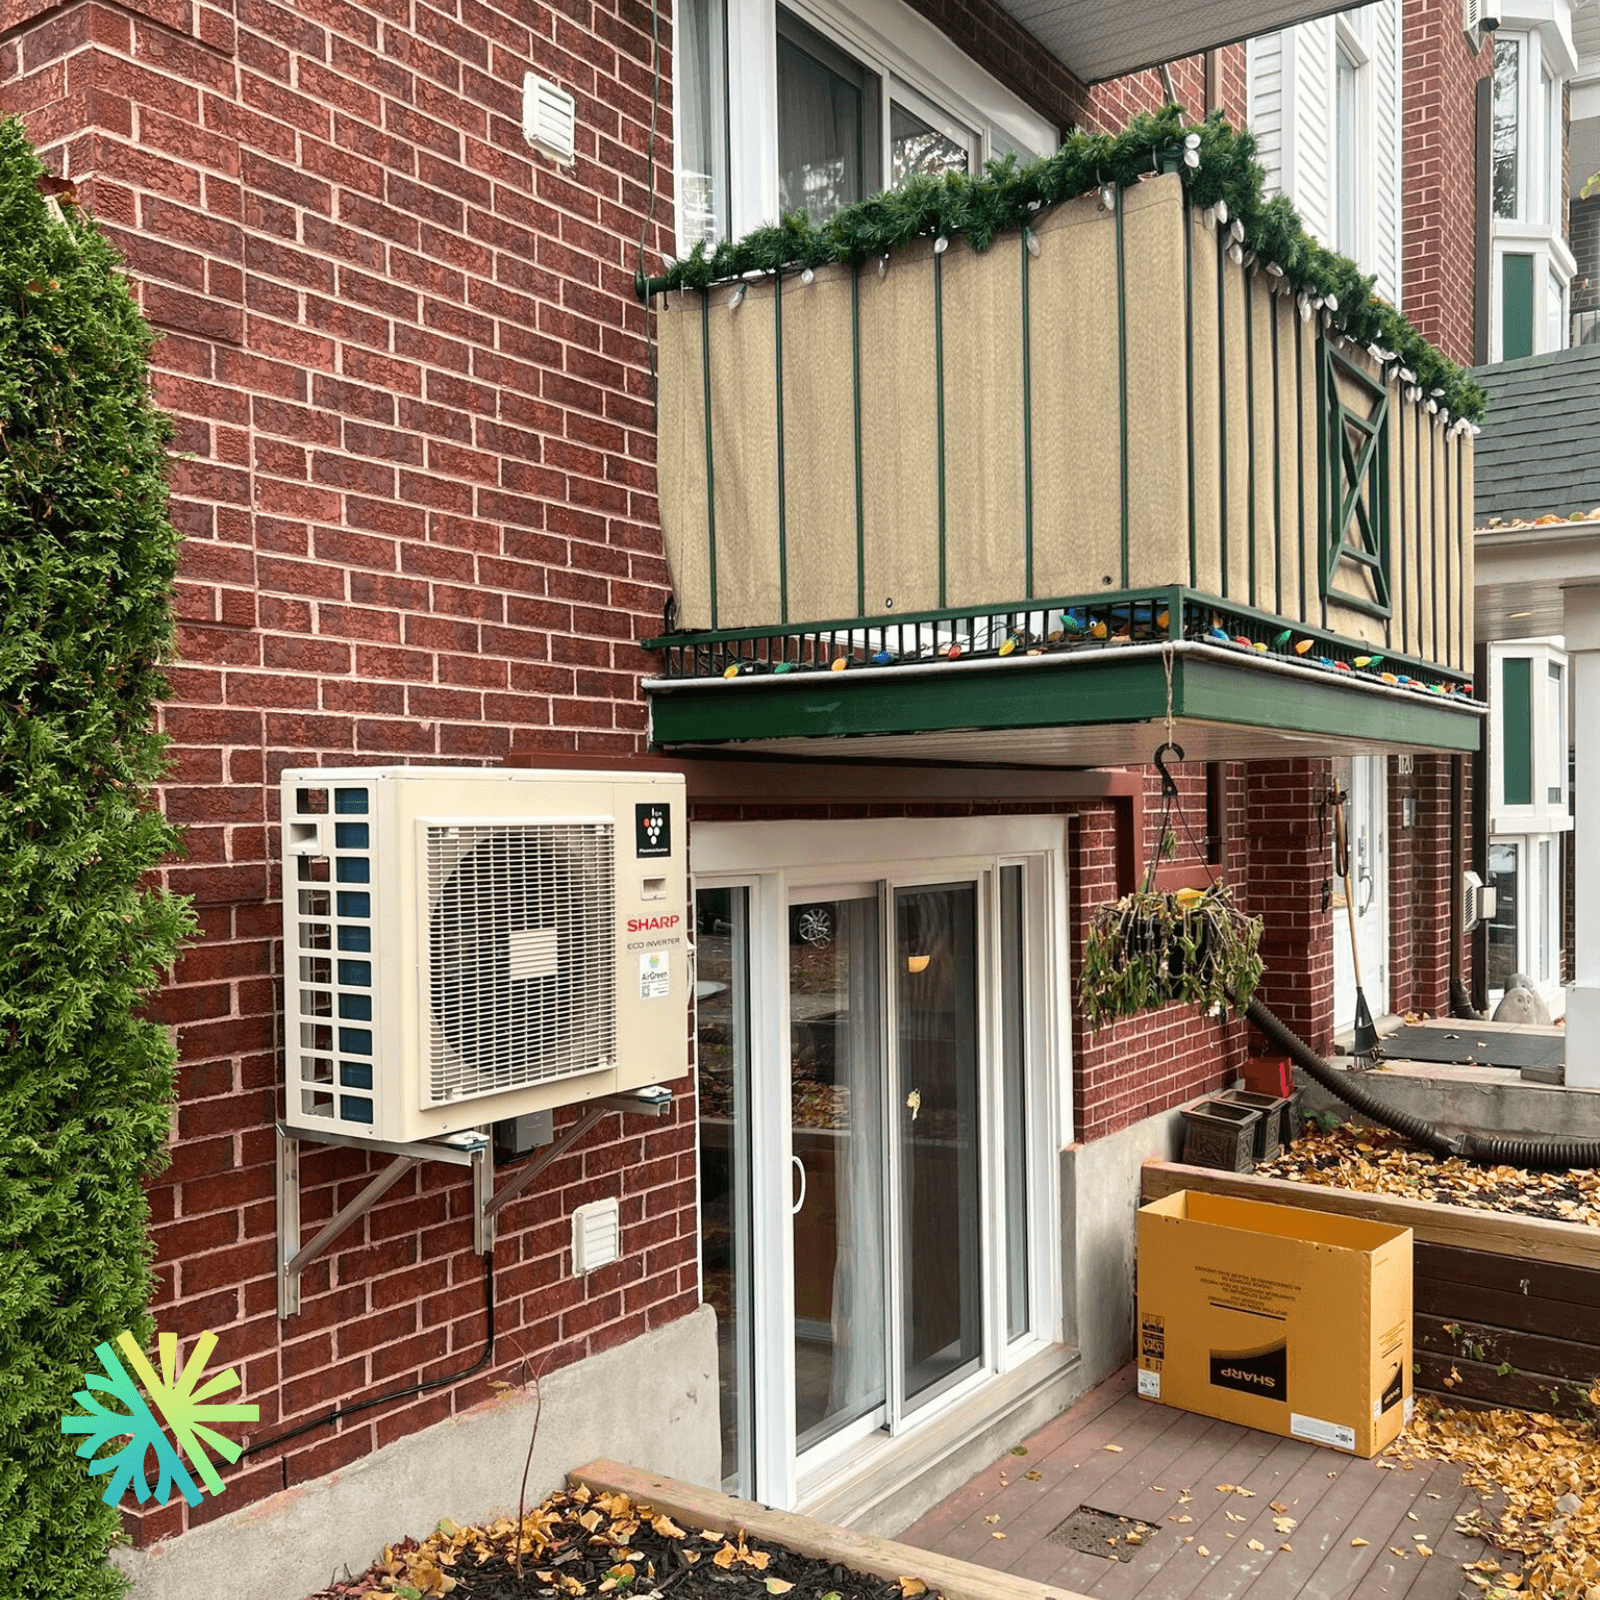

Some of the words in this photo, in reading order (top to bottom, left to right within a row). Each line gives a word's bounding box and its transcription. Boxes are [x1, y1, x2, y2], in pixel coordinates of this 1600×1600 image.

[627, 915, 680, 932] SHARP
[627, 941, 645, 950] ECO
[646, 937, 680, 947] INVERTER
[642, 971, 668, 981] AirGreen
[1221, 1368, 1275, 1387] SHARP
